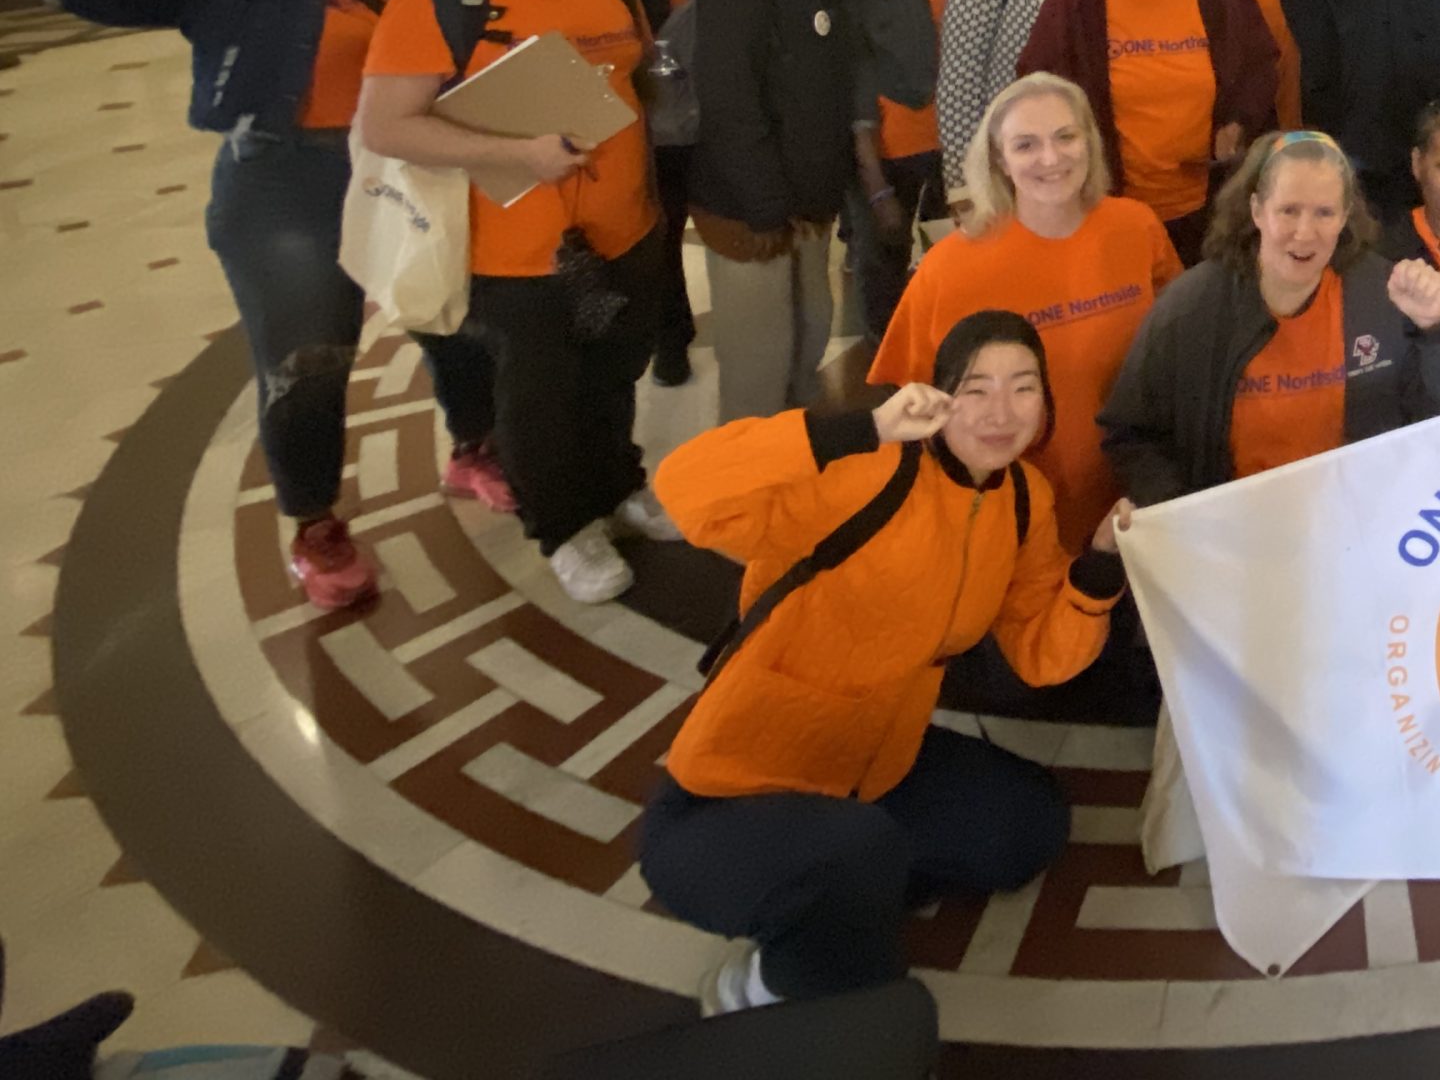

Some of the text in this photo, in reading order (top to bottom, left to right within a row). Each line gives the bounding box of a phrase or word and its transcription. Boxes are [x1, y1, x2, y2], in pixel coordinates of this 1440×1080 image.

[1123, 39, 1156, 54] ONE
[1028, 282, 1142, 326] ONE Northside
[1236, 374, 1272, 394] ONE
